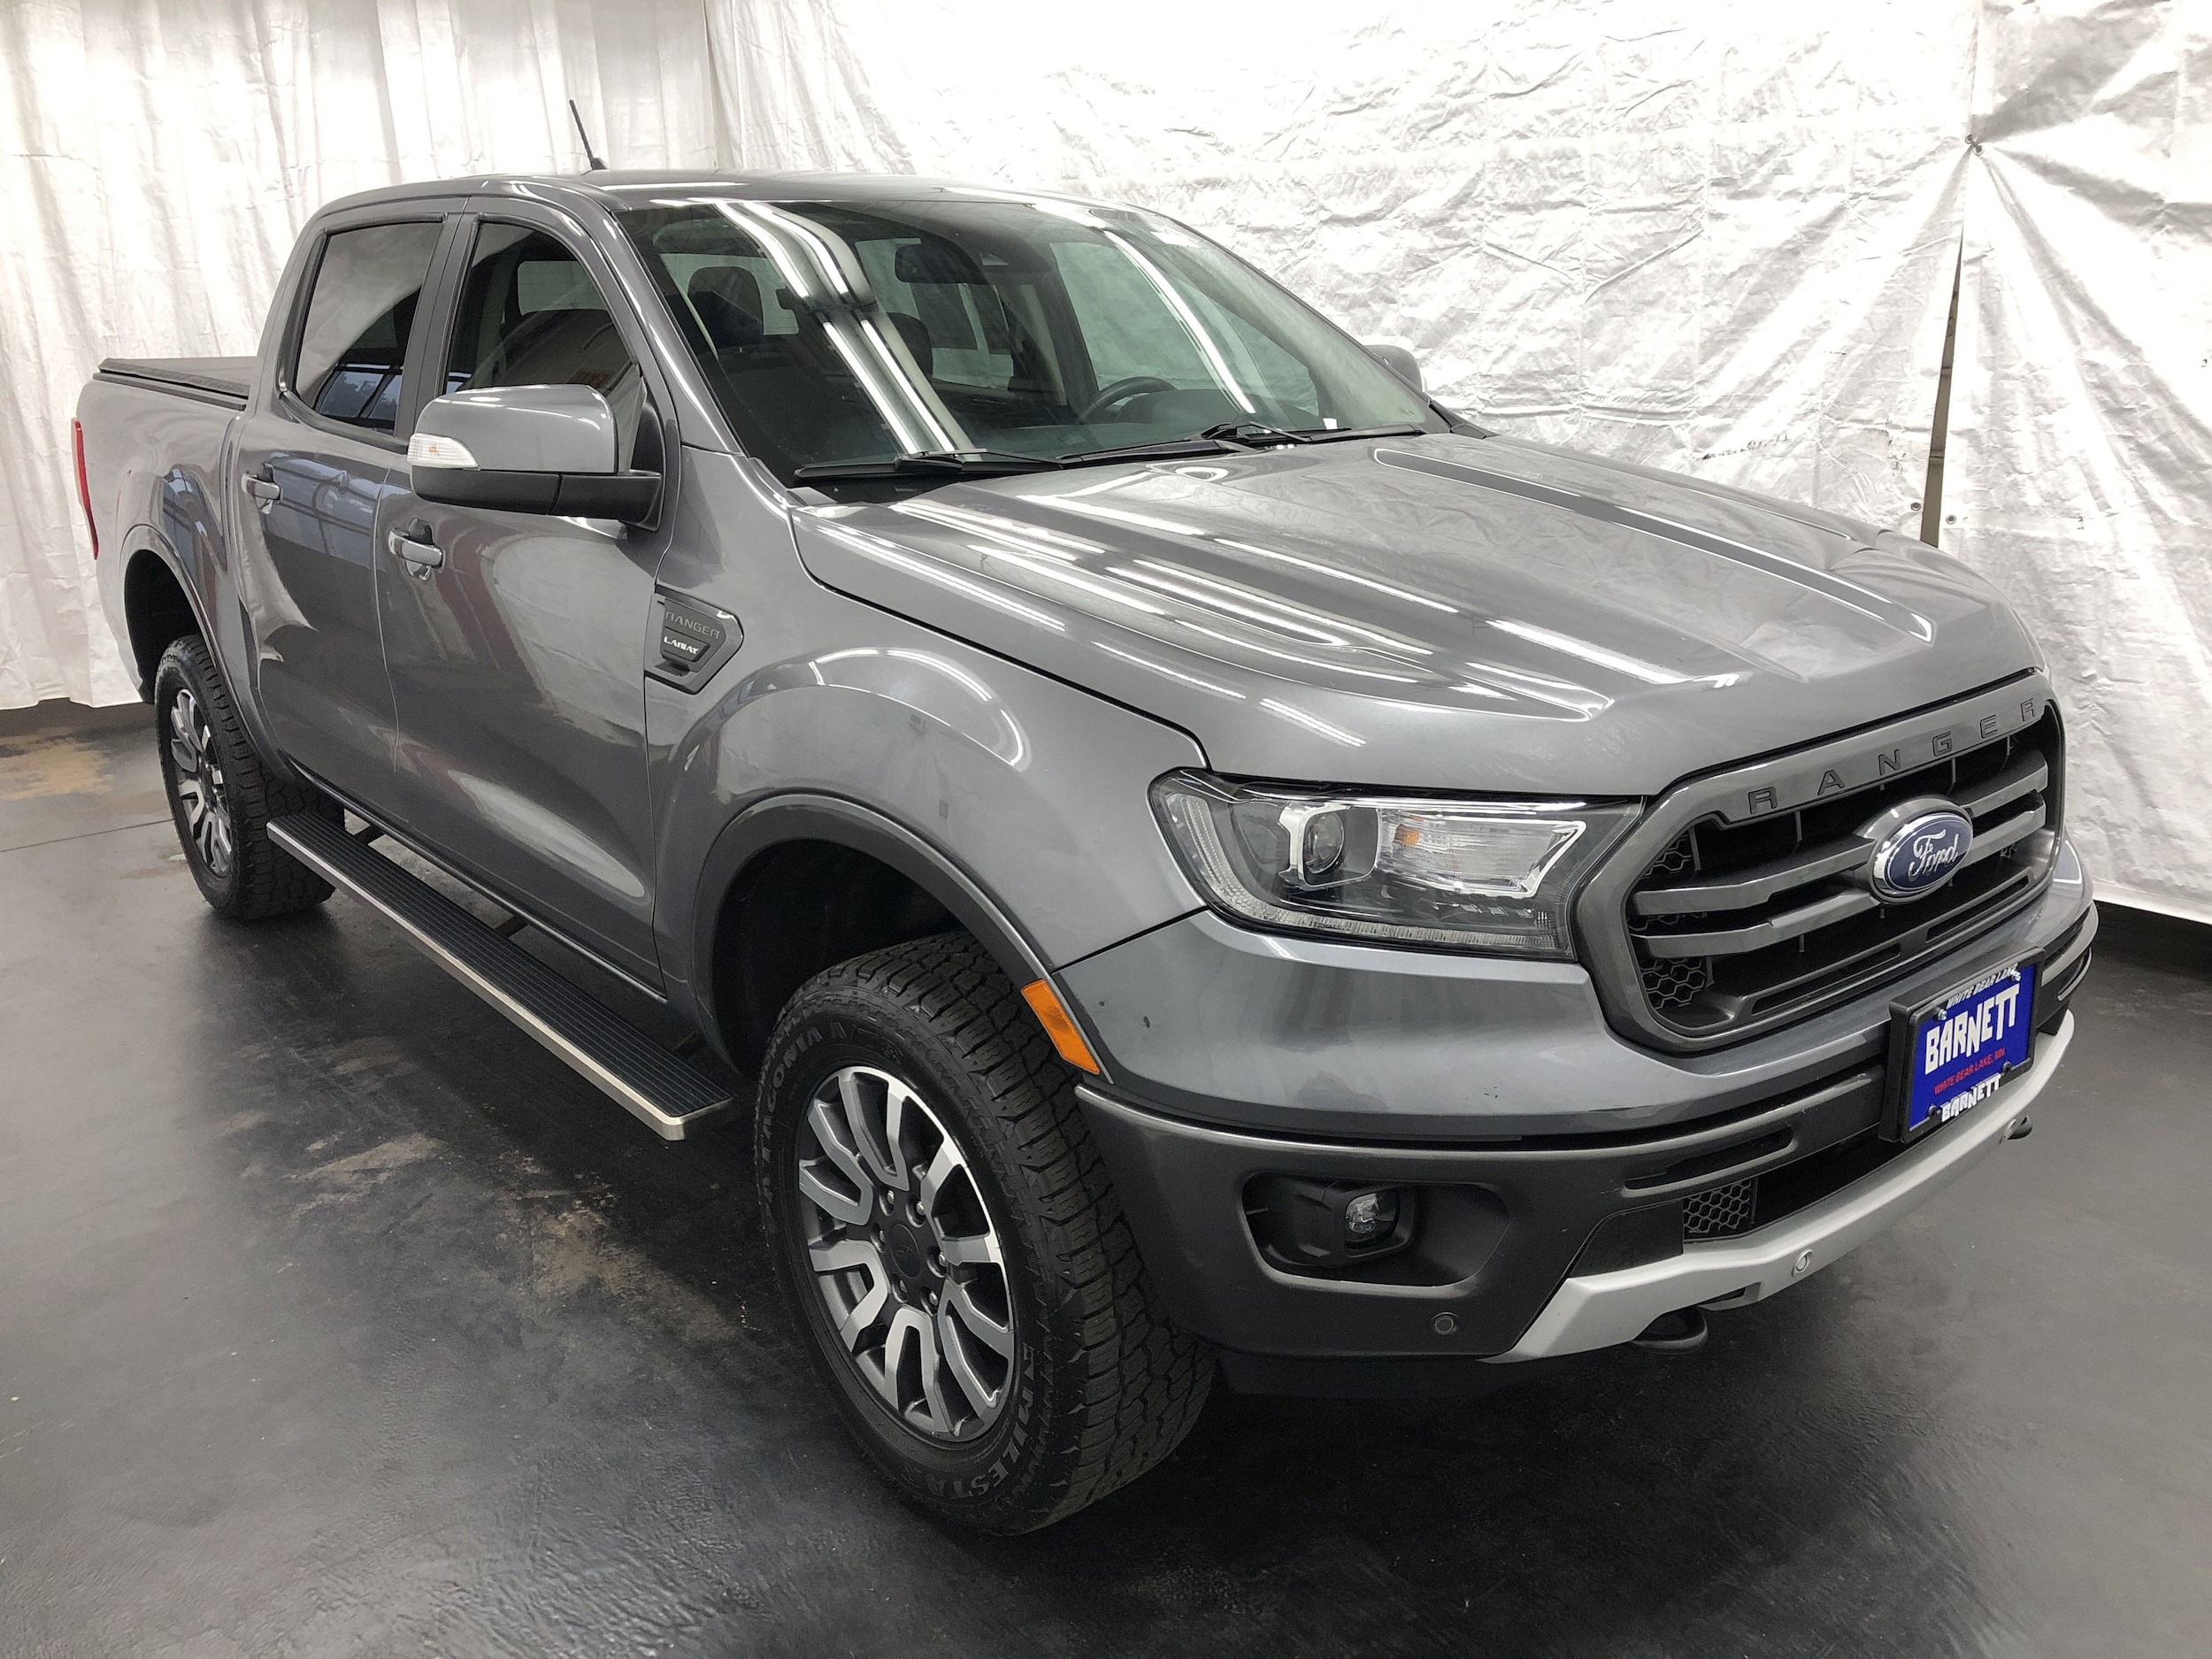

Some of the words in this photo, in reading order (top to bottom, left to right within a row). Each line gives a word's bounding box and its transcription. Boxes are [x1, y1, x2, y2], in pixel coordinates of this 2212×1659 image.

[664, 611, 720, 639] RANGER
[664, 635, 699, 655] LARIAT
[1747, 698, 2034, 815] RANGER
[1908, 829, 1960, 881] Ford
[1947, 985, 1974, 1010] WHITE
[1972, 974, 1997, 995] BEAR
[1924, 983, 2020, 1075] BARNETT
[1934, 1074, 1955, 1095] WHITE
[1955, 1064, 1974, 1082] BEAR
[1939, 1072, 2001, 1122] BARNETT
